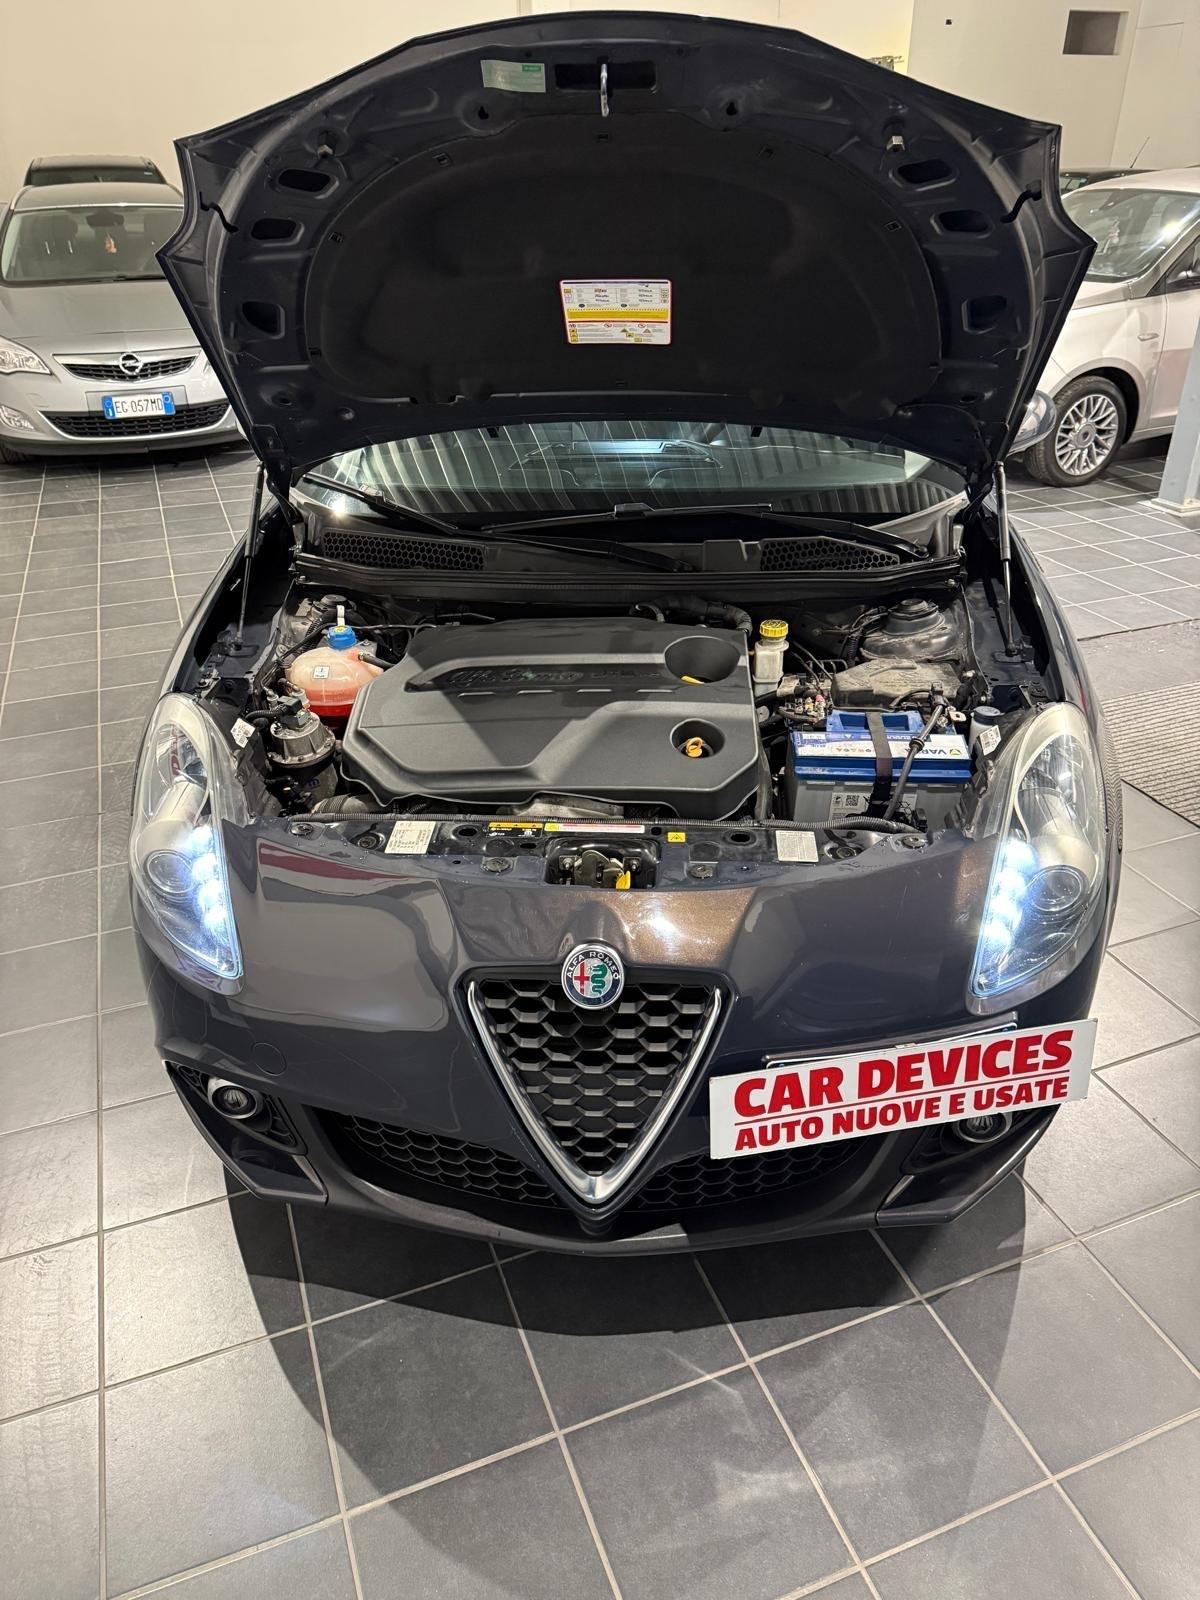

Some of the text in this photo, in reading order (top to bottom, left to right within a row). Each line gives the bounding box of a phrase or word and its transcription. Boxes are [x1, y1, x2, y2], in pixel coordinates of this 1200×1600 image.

[115, 398, 163, 414] EG 057MD
[566, 951, 620, 980] ALFA ROMEO
[734, 1029, 1074, 1118] CAR DEVICES
[735, 1076, 1069, 1151] AUTO NUOVE E USATE
